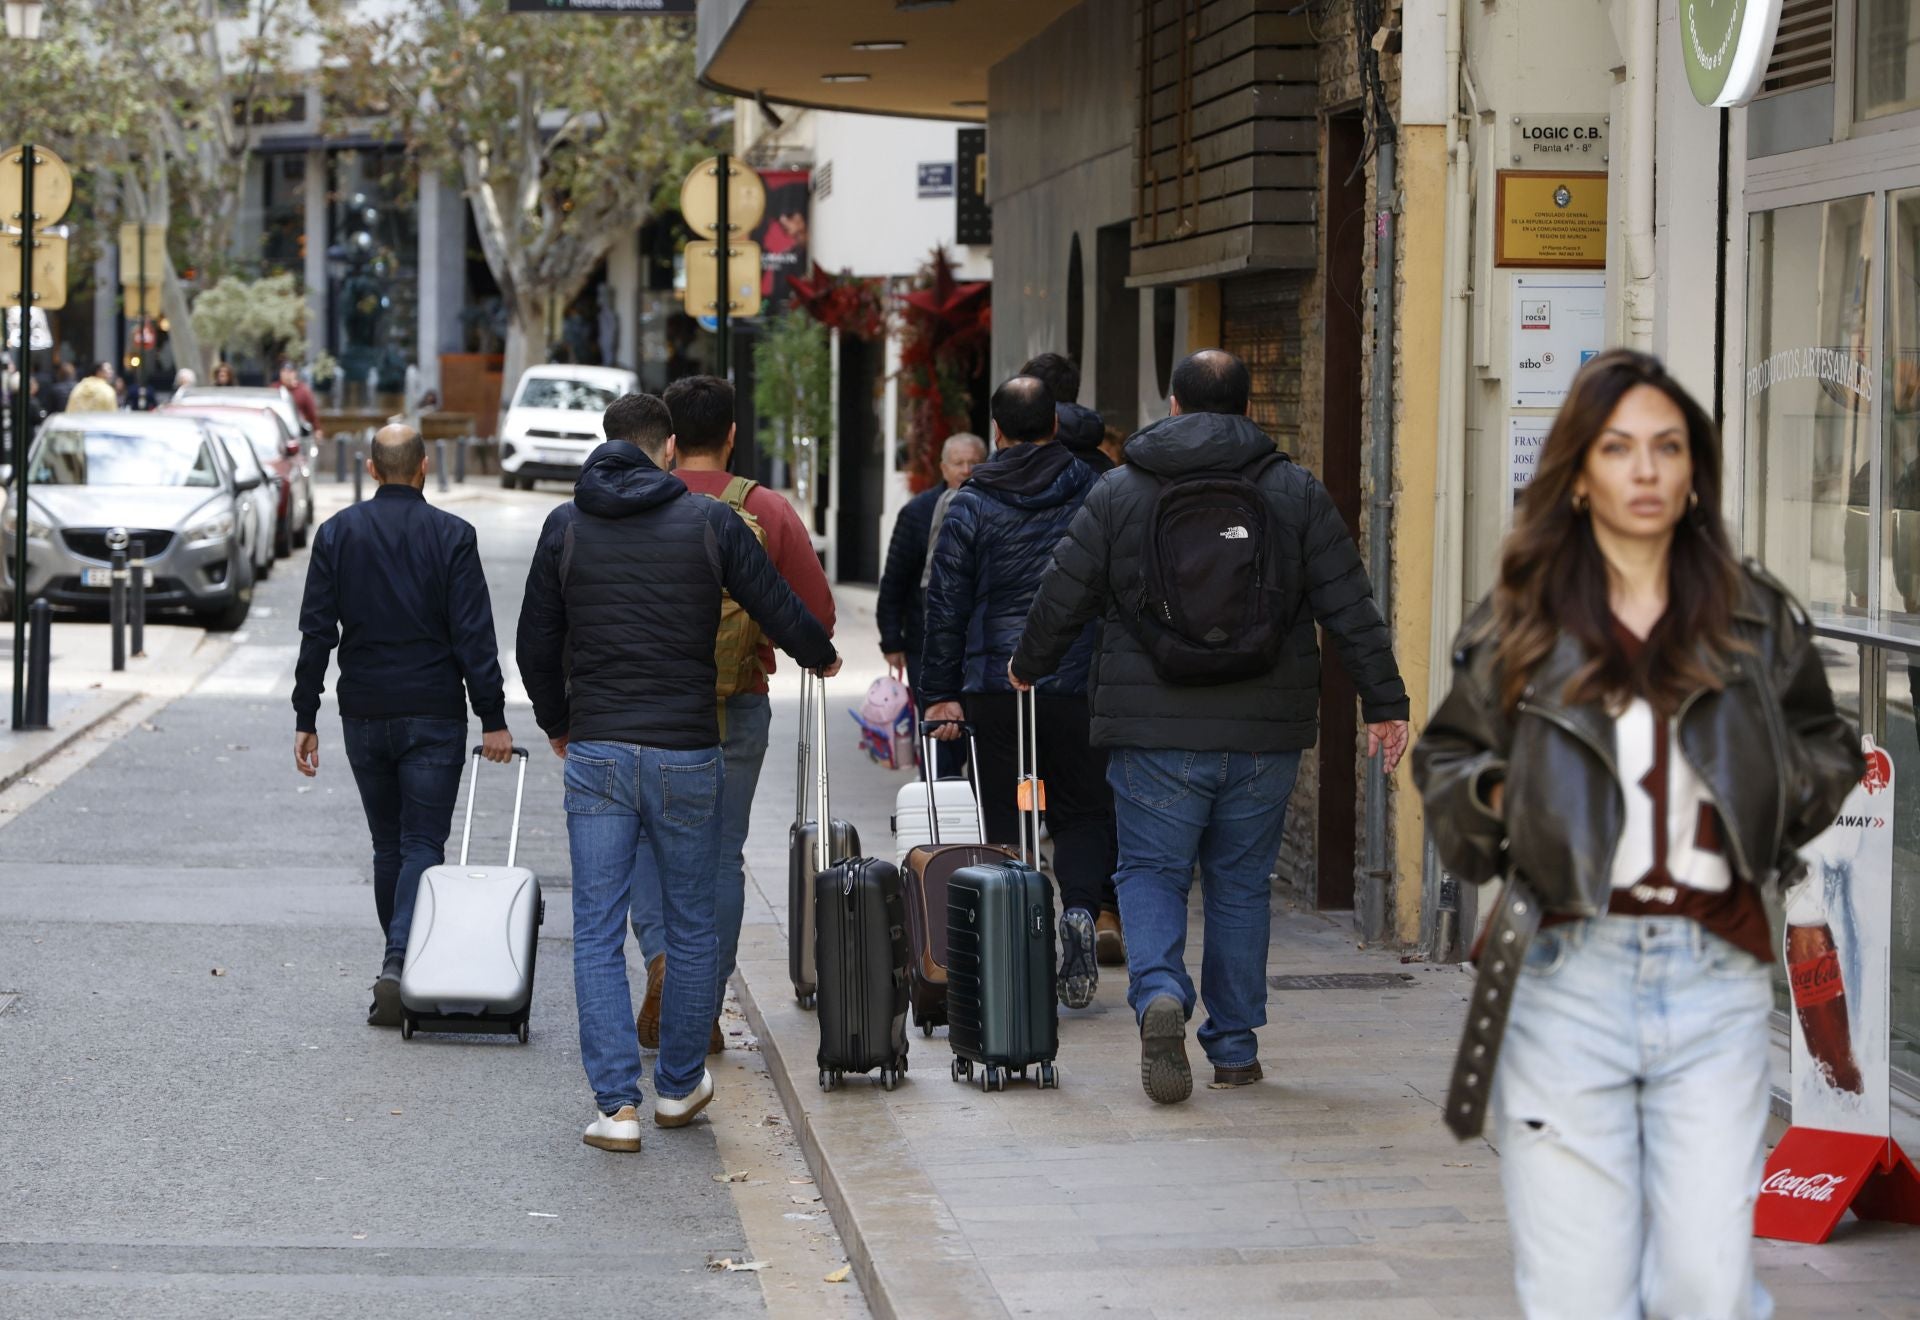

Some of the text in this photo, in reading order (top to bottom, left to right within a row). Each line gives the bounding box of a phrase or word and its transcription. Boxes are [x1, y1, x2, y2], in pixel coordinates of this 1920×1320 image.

[1522, 127, 1602, 139] LOGIC C.B.
[1533, 143, 1561, 152] Planta
[1519, 358, 1541, 369] sibo
[1746, 347, 1872, 401] PRODUCTOS ARTESANALES
[1514, 452, 1535, 464] JOSÉ
[1836, 815, 1872, 828] AWAY
